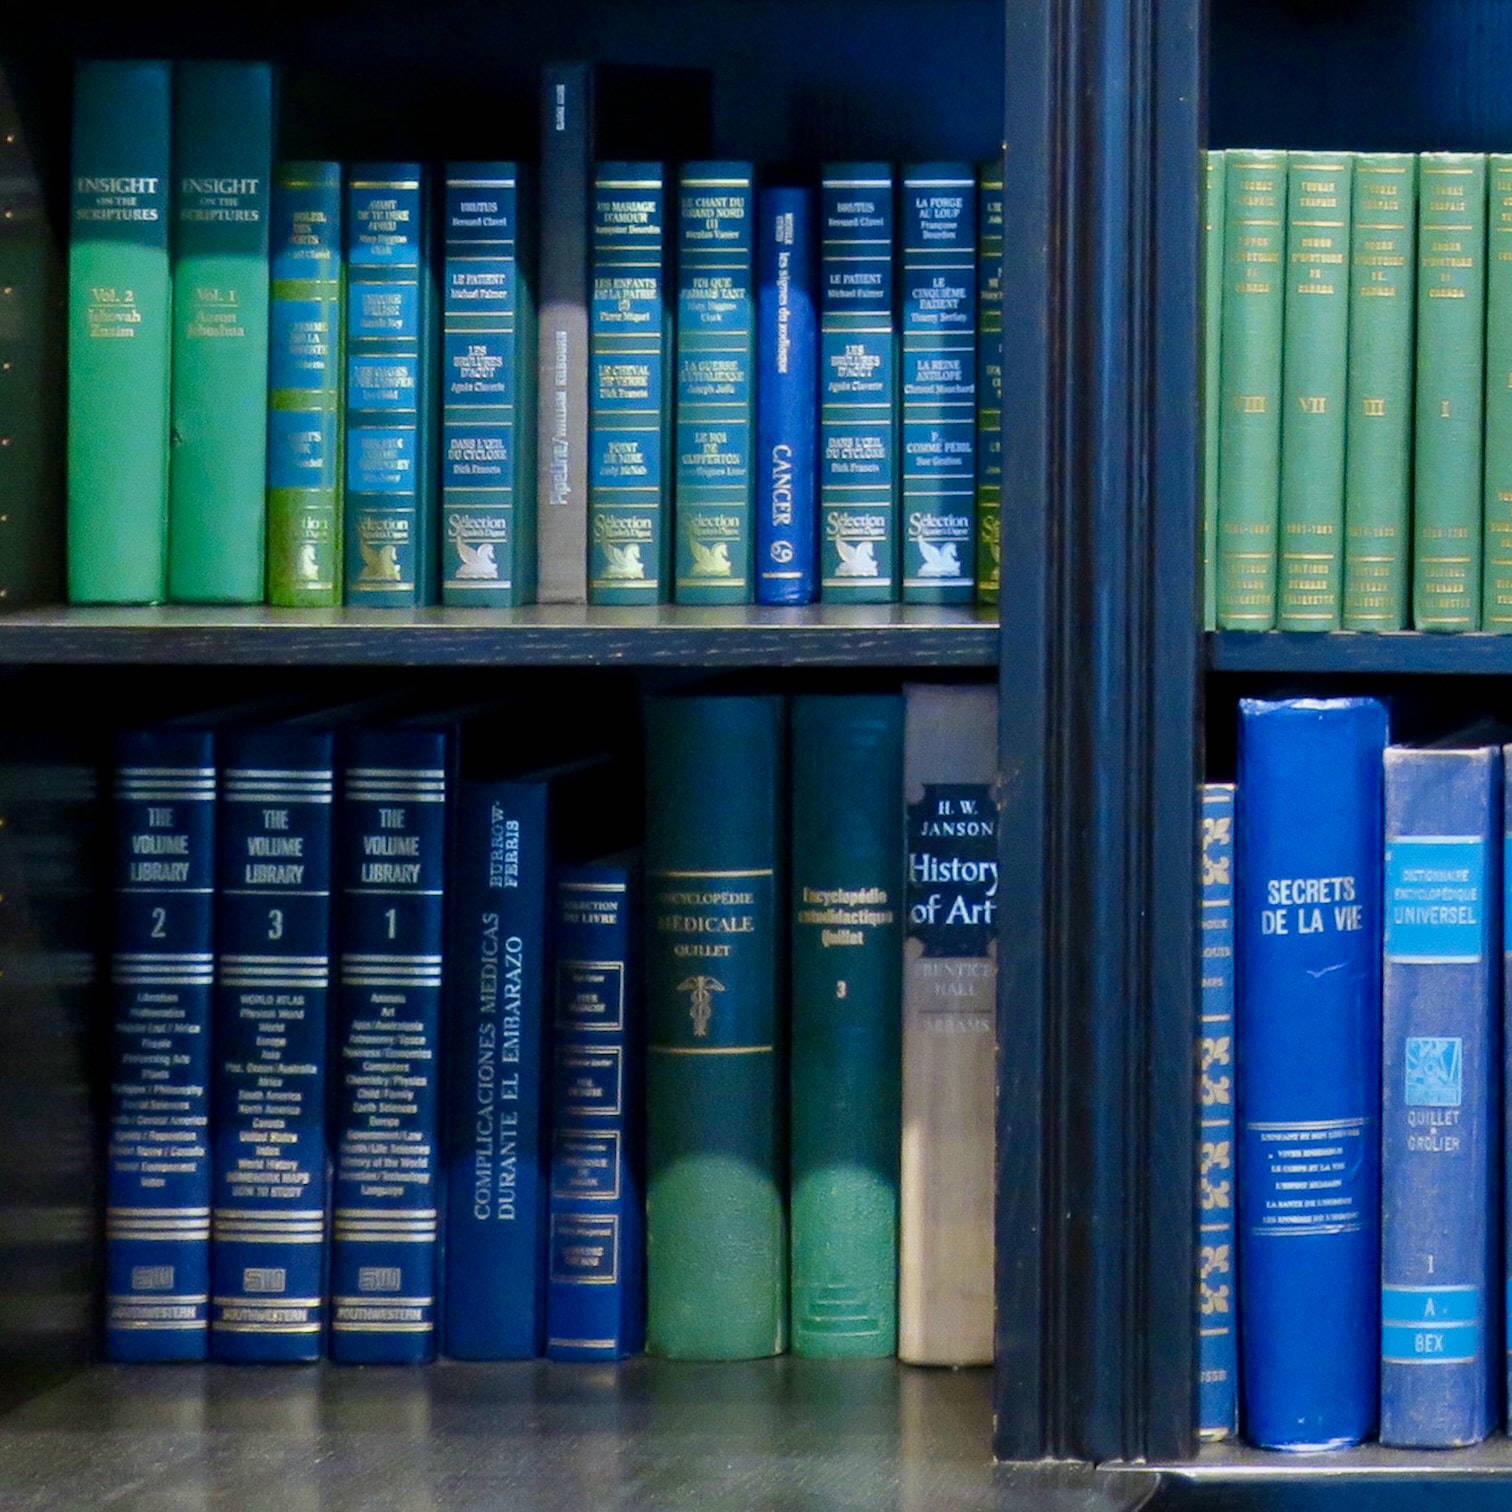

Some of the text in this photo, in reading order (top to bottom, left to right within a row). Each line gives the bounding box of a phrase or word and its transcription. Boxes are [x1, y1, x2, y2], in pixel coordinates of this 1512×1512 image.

[78, 177, 158, 195] INSIGHT
[76, 208, 158, 221] SCRIPTURES
[1298, 397, 1326, 414] VII
[771, 444, 792, 527] CANCER
[148, 809, 173, 828] THE
[920, 820, 994, 837] JANSON
[132, 836, 188, 856] VOLUME
[504, 820, 519, 888] FERRIS
[130, 863, 189, 883] LIBRARY
[909, 854, 999, 894] History
[1268, 877, 1355, 904] SECRETS
[152, 908, 166, 938] 2
[386, 909, 396, 938] 1
[911, 895, 996, 924] of Art
[1261, 903, 1362, 934] DE LA VIE
[268, 910, 283, 940] 3
[474, 912, 499, 1220] COMPLICACIONES MEDICAS
[499, 936, 523, 1220] DURANTE EL EMBARAZO
[1415, 1332, 1443, 1353] BEX
